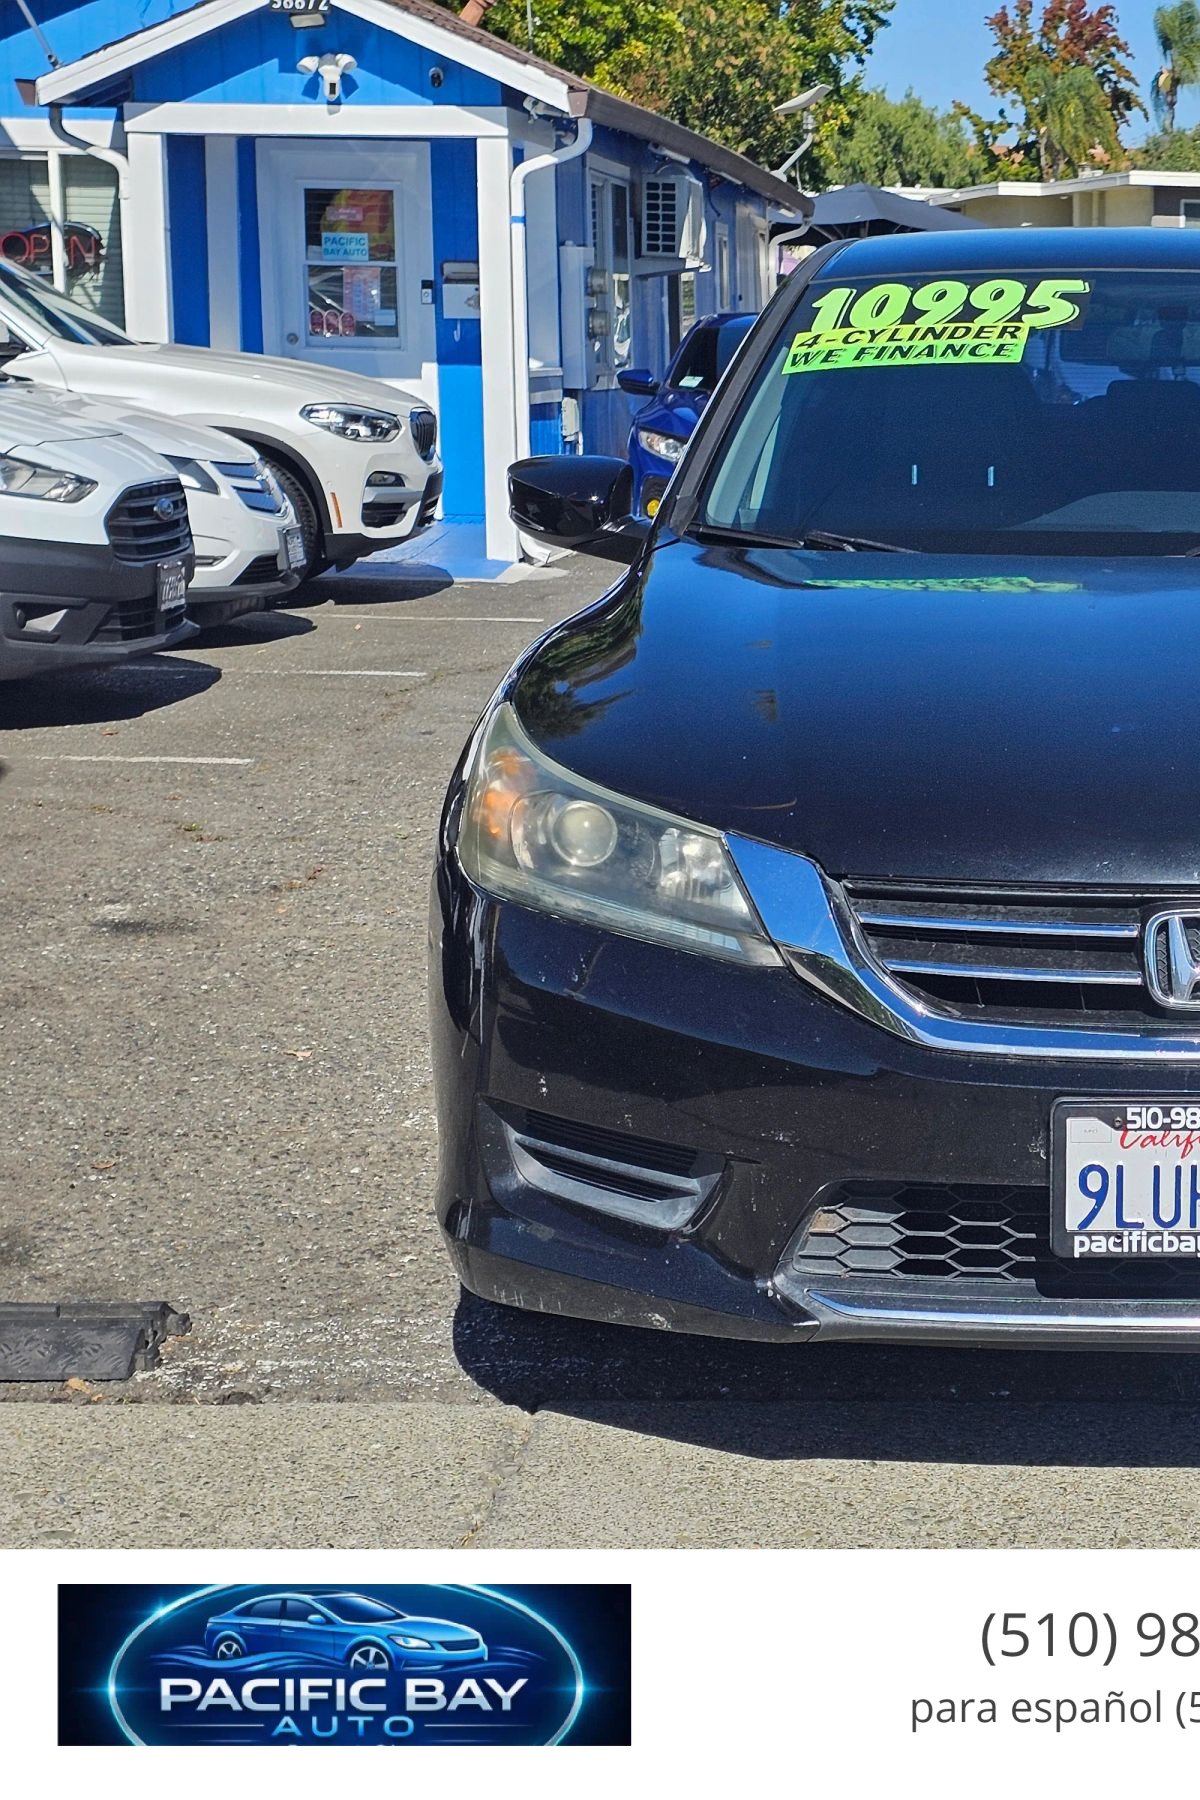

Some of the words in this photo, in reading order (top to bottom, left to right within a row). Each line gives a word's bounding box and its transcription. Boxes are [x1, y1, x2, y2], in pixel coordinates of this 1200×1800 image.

[0, 230, 96, 269] OPN
[323, 236, 366, 246] PACIFIC
[323, 247, 341, 257] BAY
[342, 247, 367, 257] AUTO
[811, 279, 1090, 332] 10995
[795, 324, 1023, 350] 4-CYLINDER
[789, 349, 840, 368] WE
[852, 341, 1018, 362] FINANCE
